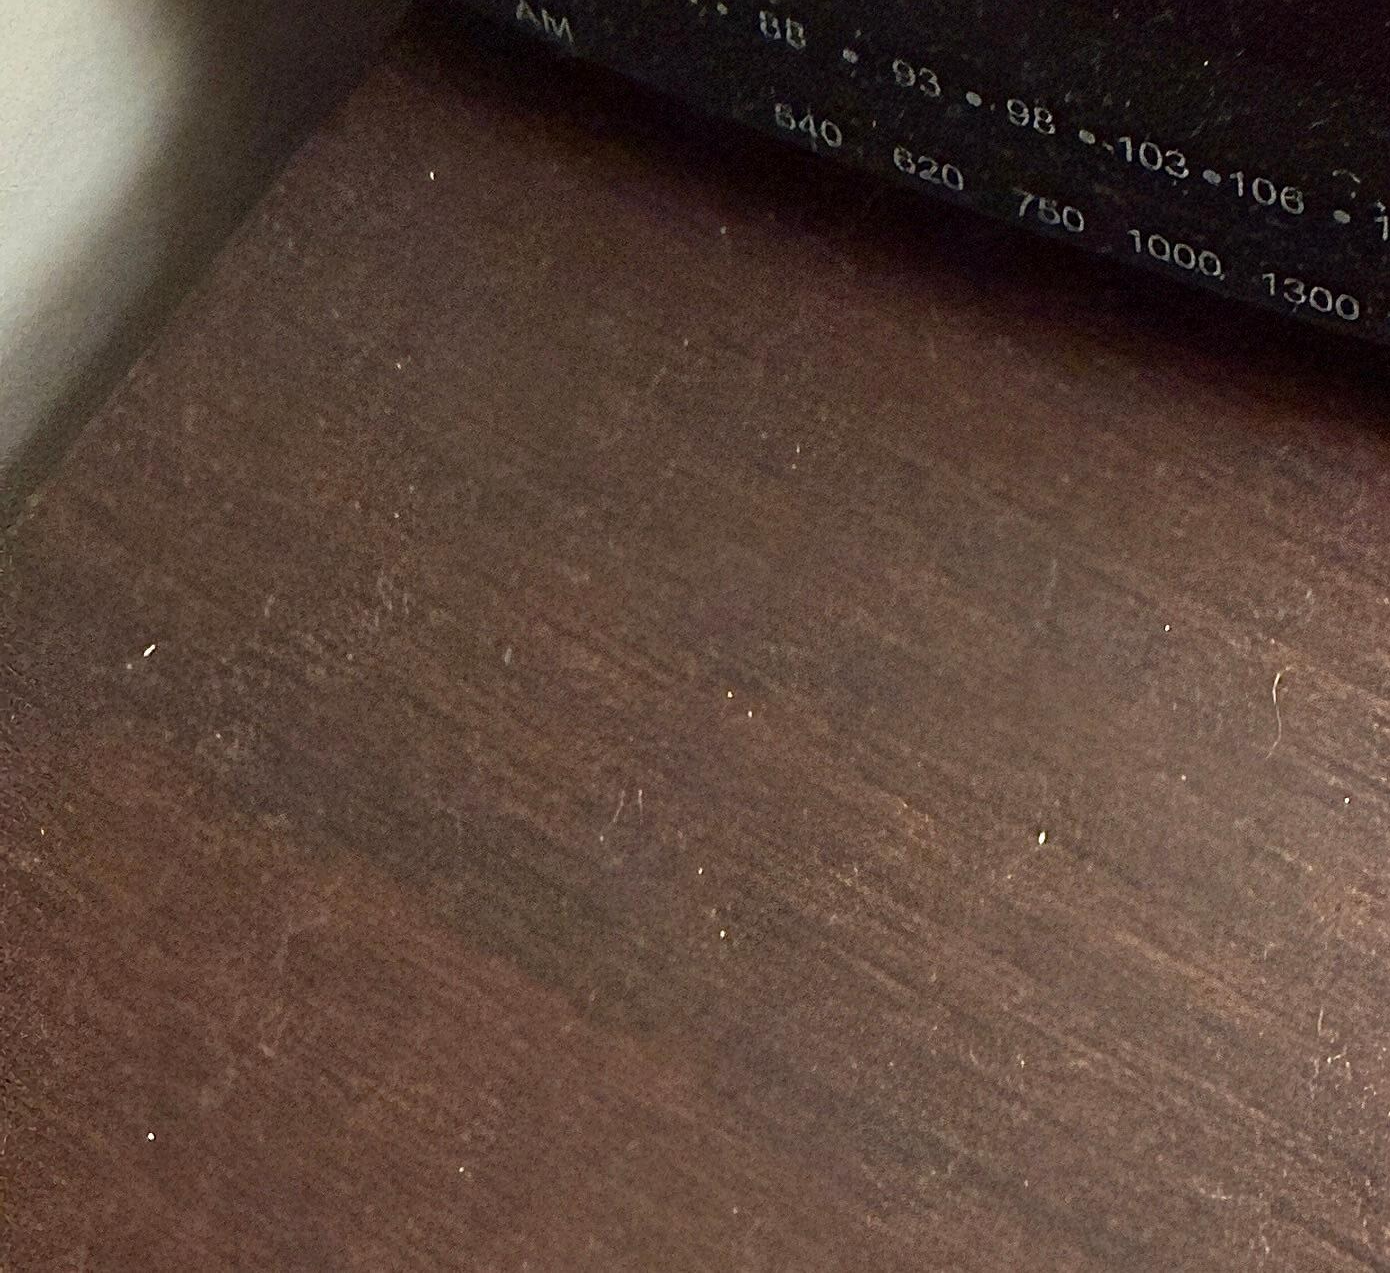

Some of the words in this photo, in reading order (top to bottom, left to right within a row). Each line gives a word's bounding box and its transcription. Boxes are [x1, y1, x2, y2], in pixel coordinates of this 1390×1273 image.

[891, 58, 942, 99] 93
[1005, 97, 1057, 136] 98
[1117, 135, 1190, 180] 103
[1229, 170, 1306, 216] 106
[1127, 228, 1222, 279] 1000
[1261, 271, 1362, 322] 1300
